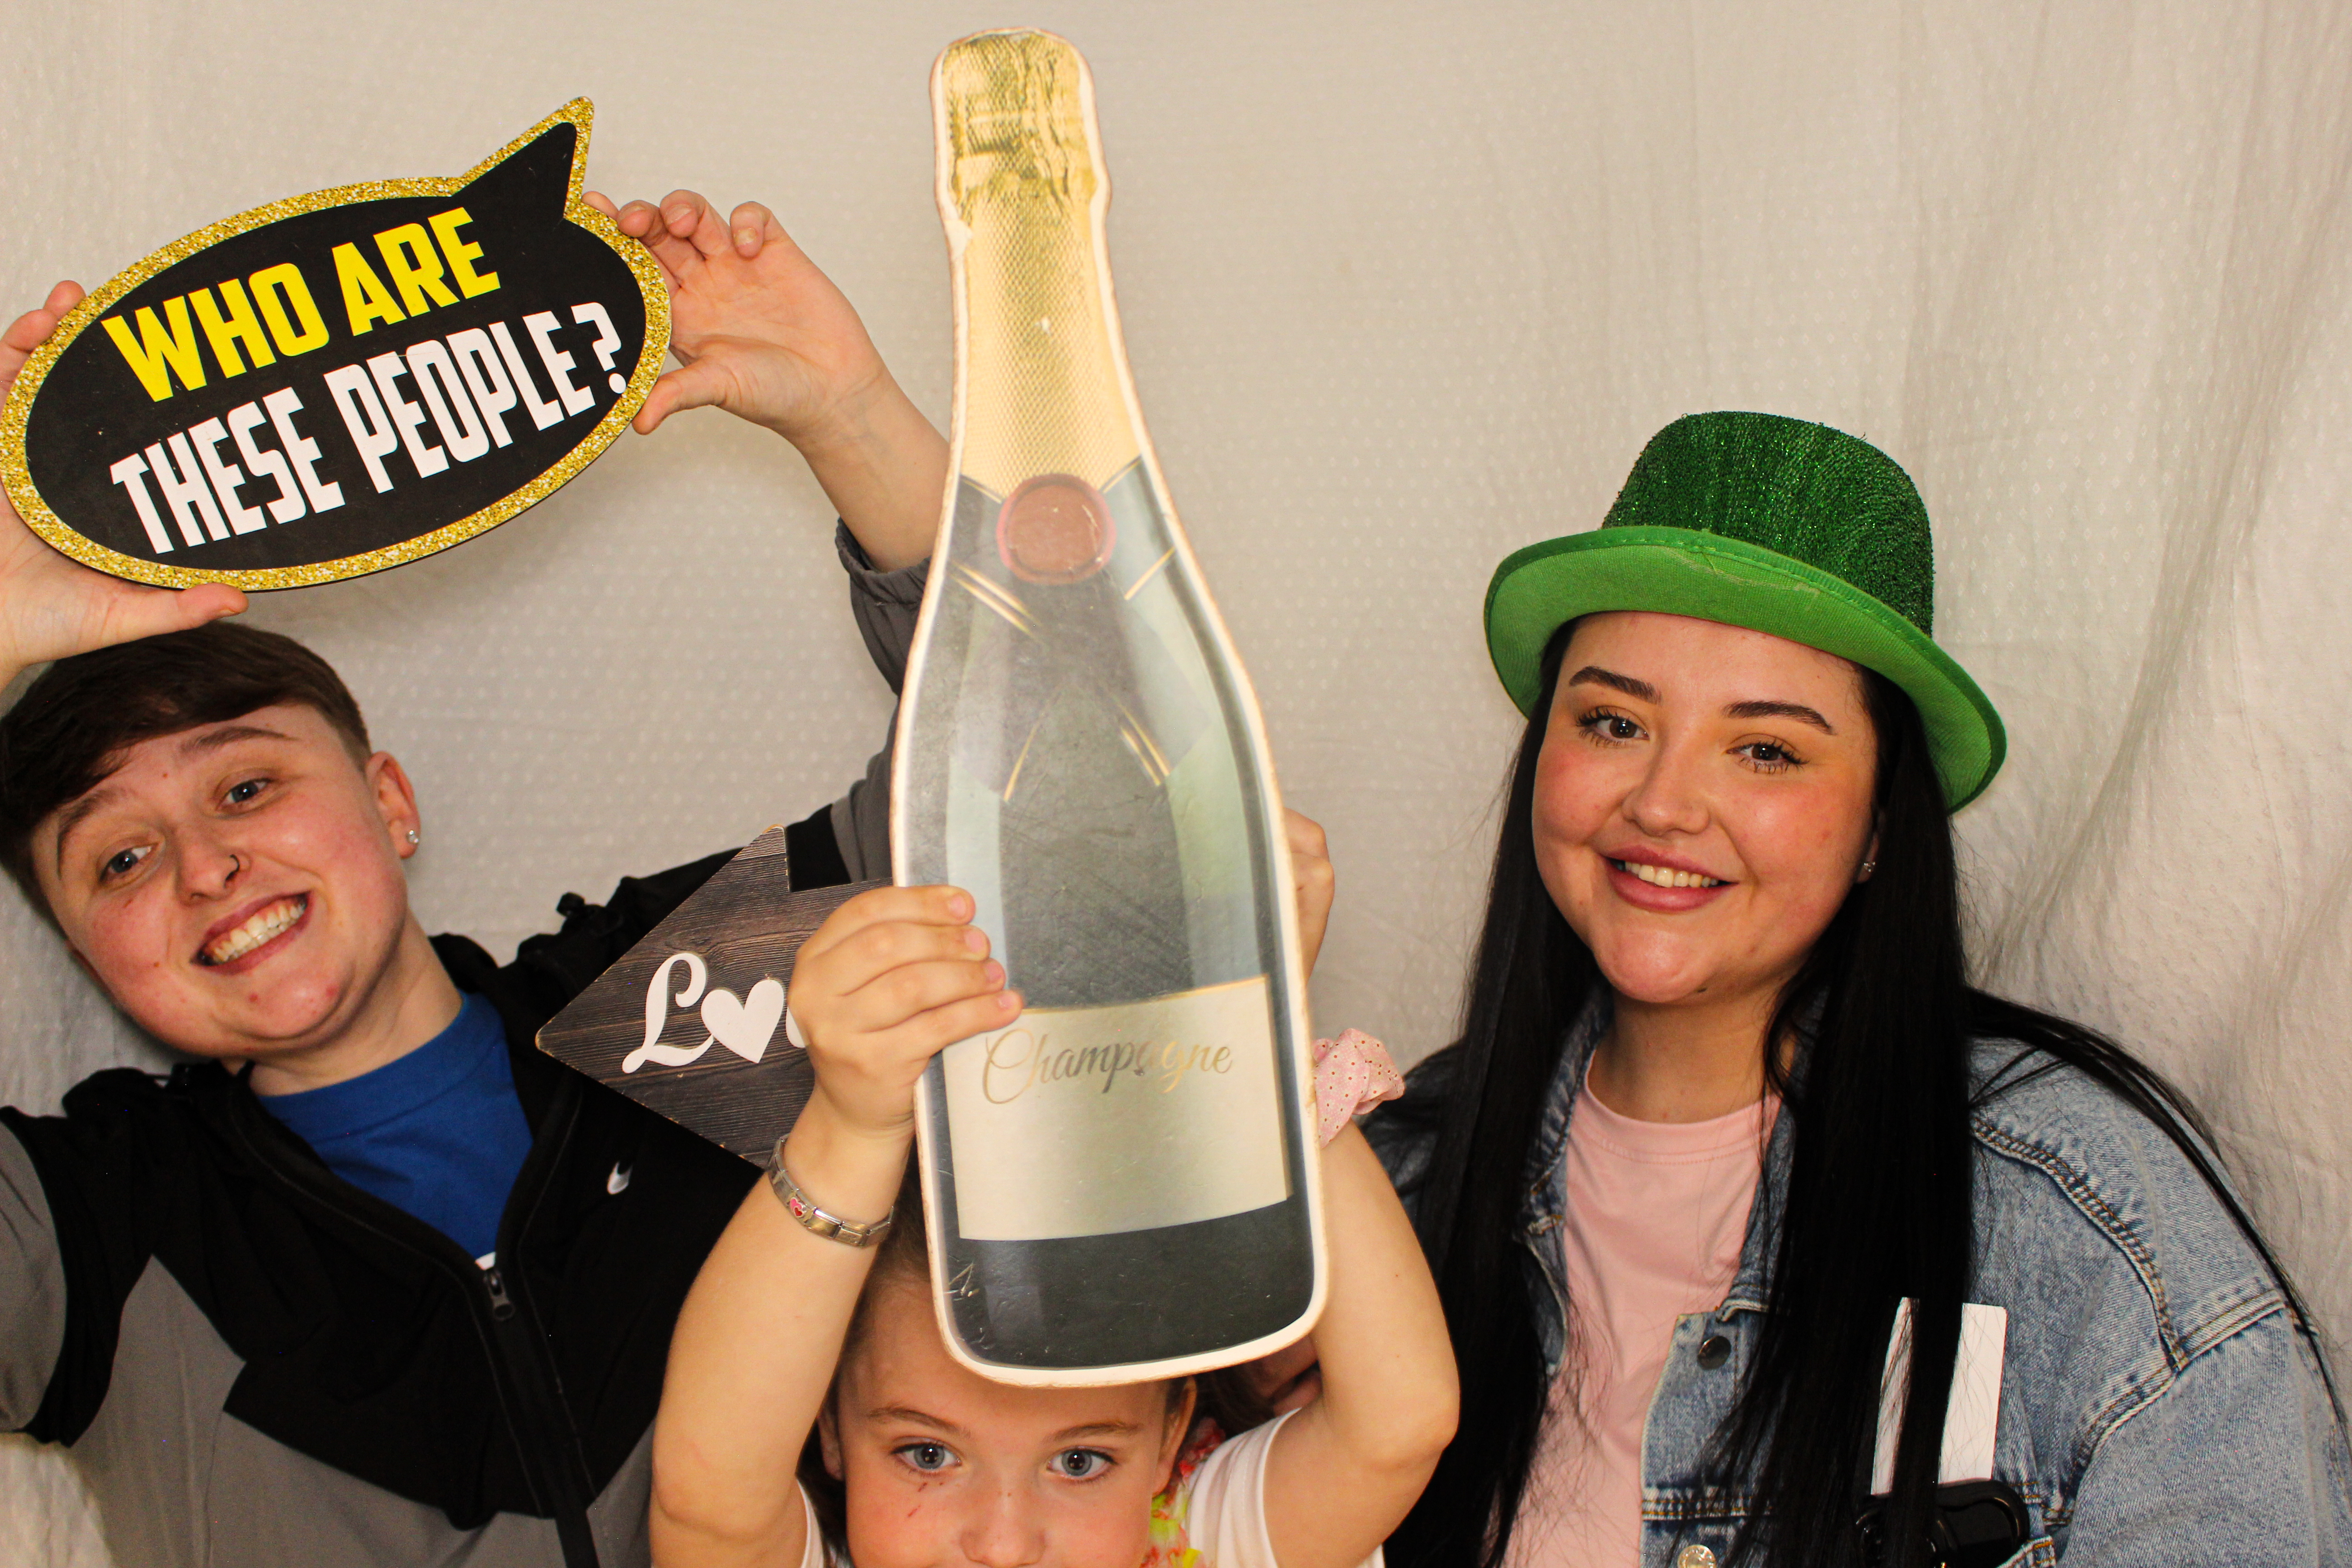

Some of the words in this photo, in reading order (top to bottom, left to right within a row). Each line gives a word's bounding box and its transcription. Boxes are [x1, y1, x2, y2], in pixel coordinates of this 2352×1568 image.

[101, 262, 329, 402] WHO
[332, 206, 500, 336] ARE
[109, 386, 345, 554] THESE
[323, 302, 627, 493] PEOPLE?
[982, 1028, 1234, 1104] Champagne
